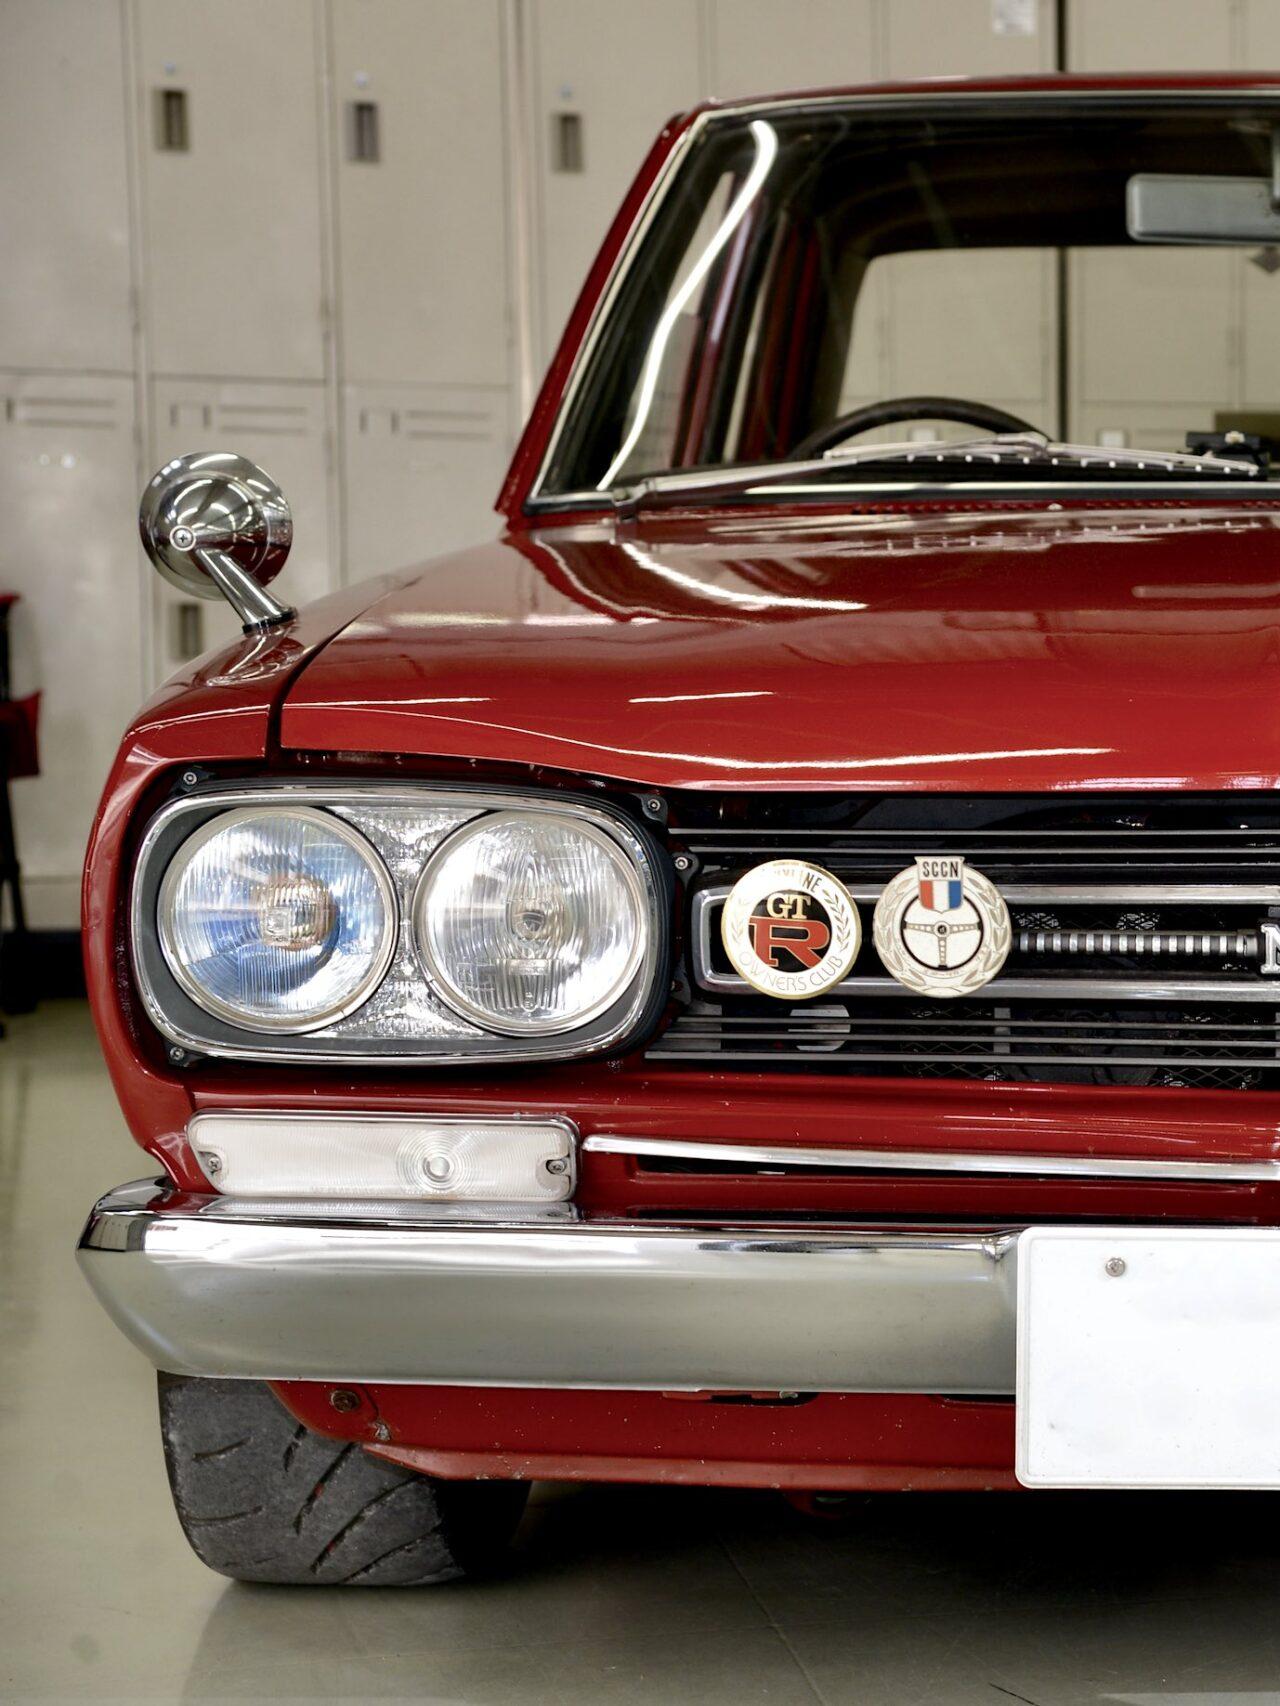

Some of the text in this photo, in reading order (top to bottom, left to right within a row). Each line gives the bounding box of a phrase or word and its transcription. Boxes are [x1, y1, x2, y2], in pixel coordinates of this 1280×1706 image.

[923, 861, 960, 878] SCCN
[766, 892, 811, 919] GT
[748, 916, 830, 968] R
[739, 951, 843, 991] OWNER'S CLUB
